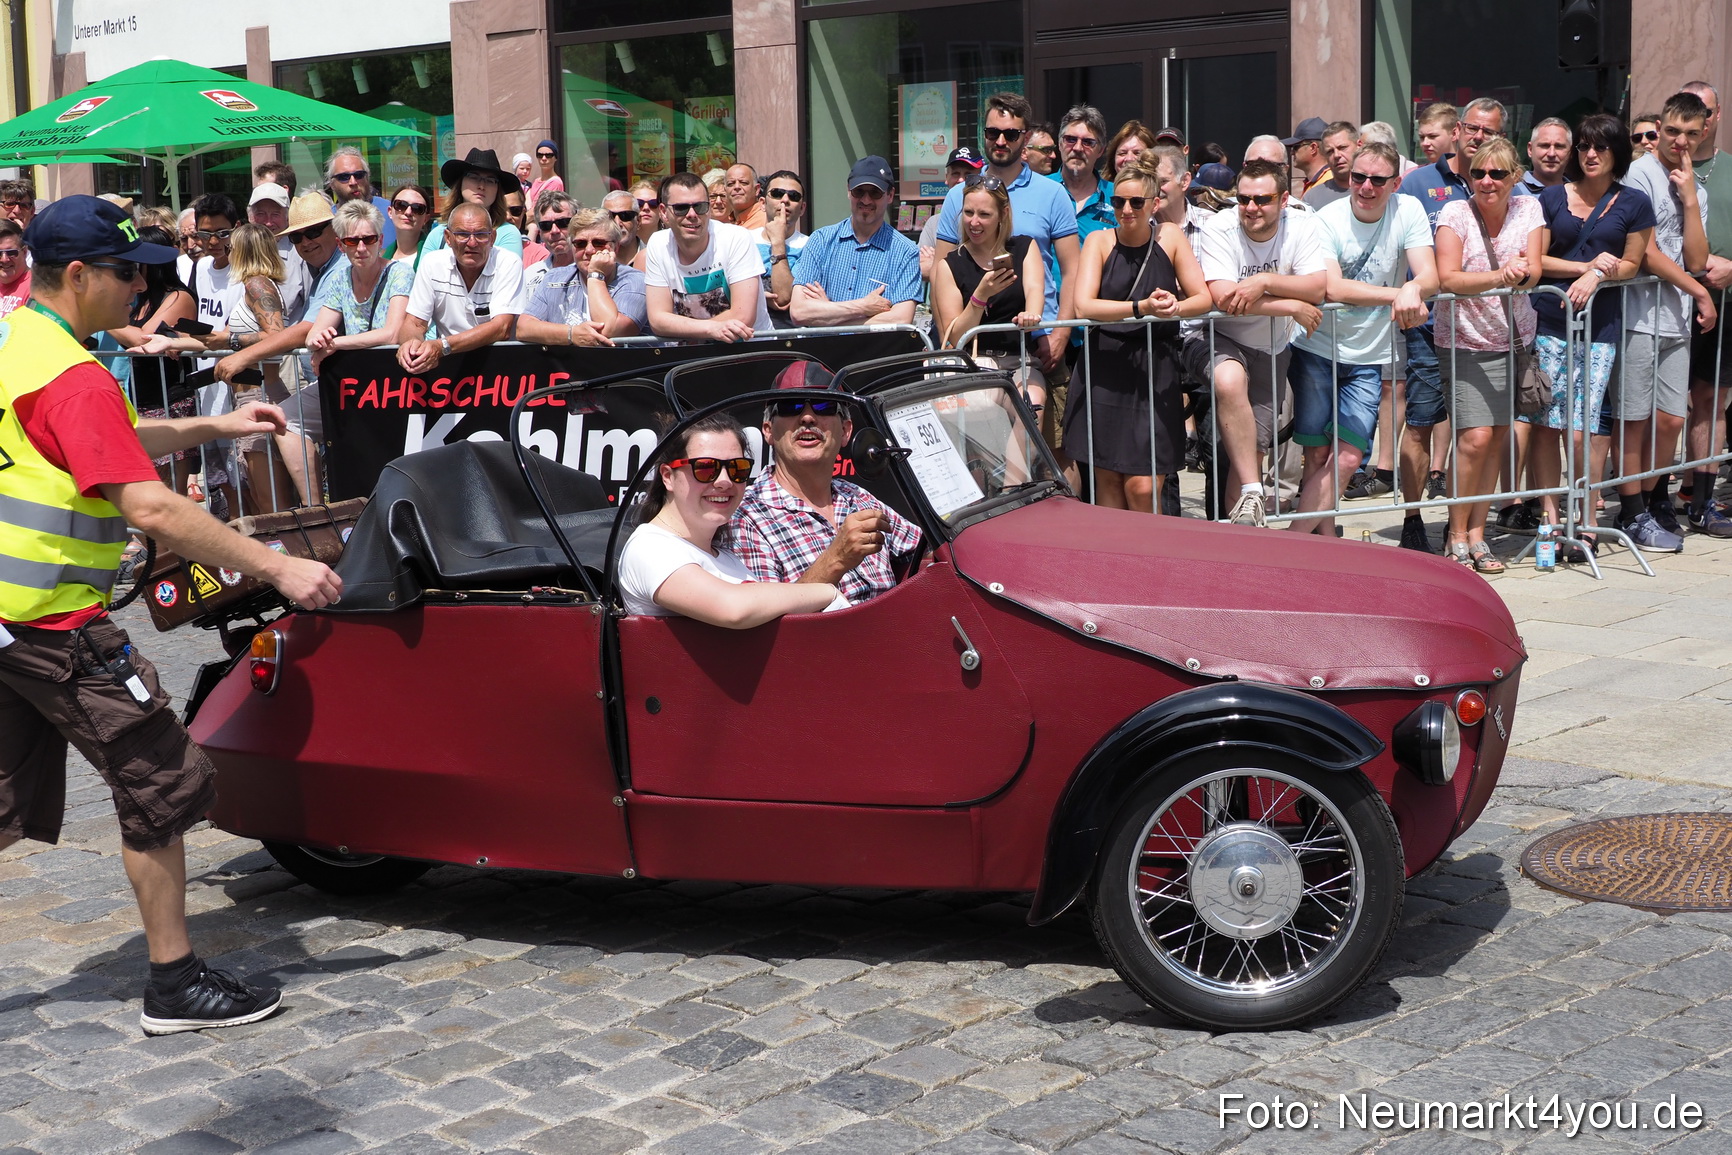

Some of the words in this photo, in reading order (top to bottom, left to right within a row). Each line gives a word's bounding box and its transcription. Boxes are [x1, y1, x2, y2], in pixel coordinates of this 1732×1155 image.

[74, 24, 101, 40] Unterer
[103, 18, 126, 36] Markt
[128, 15, 138, 32] 15
[213, 113, 304, 125] Neumarkter
[692, 105, 730, 120] Grillen
[12, 124, 91, 139] Neumarkter
[208, 121, 337, 136] Lammsbräu
[638, 118, 663, 131] BURGER
[0, 133, 88, 150] ammsbräu
[200, 297, 224, 318] FILA
[339, 371, 571, 410] FAHRSCHULE
[917, 422, 942, 447] 592
